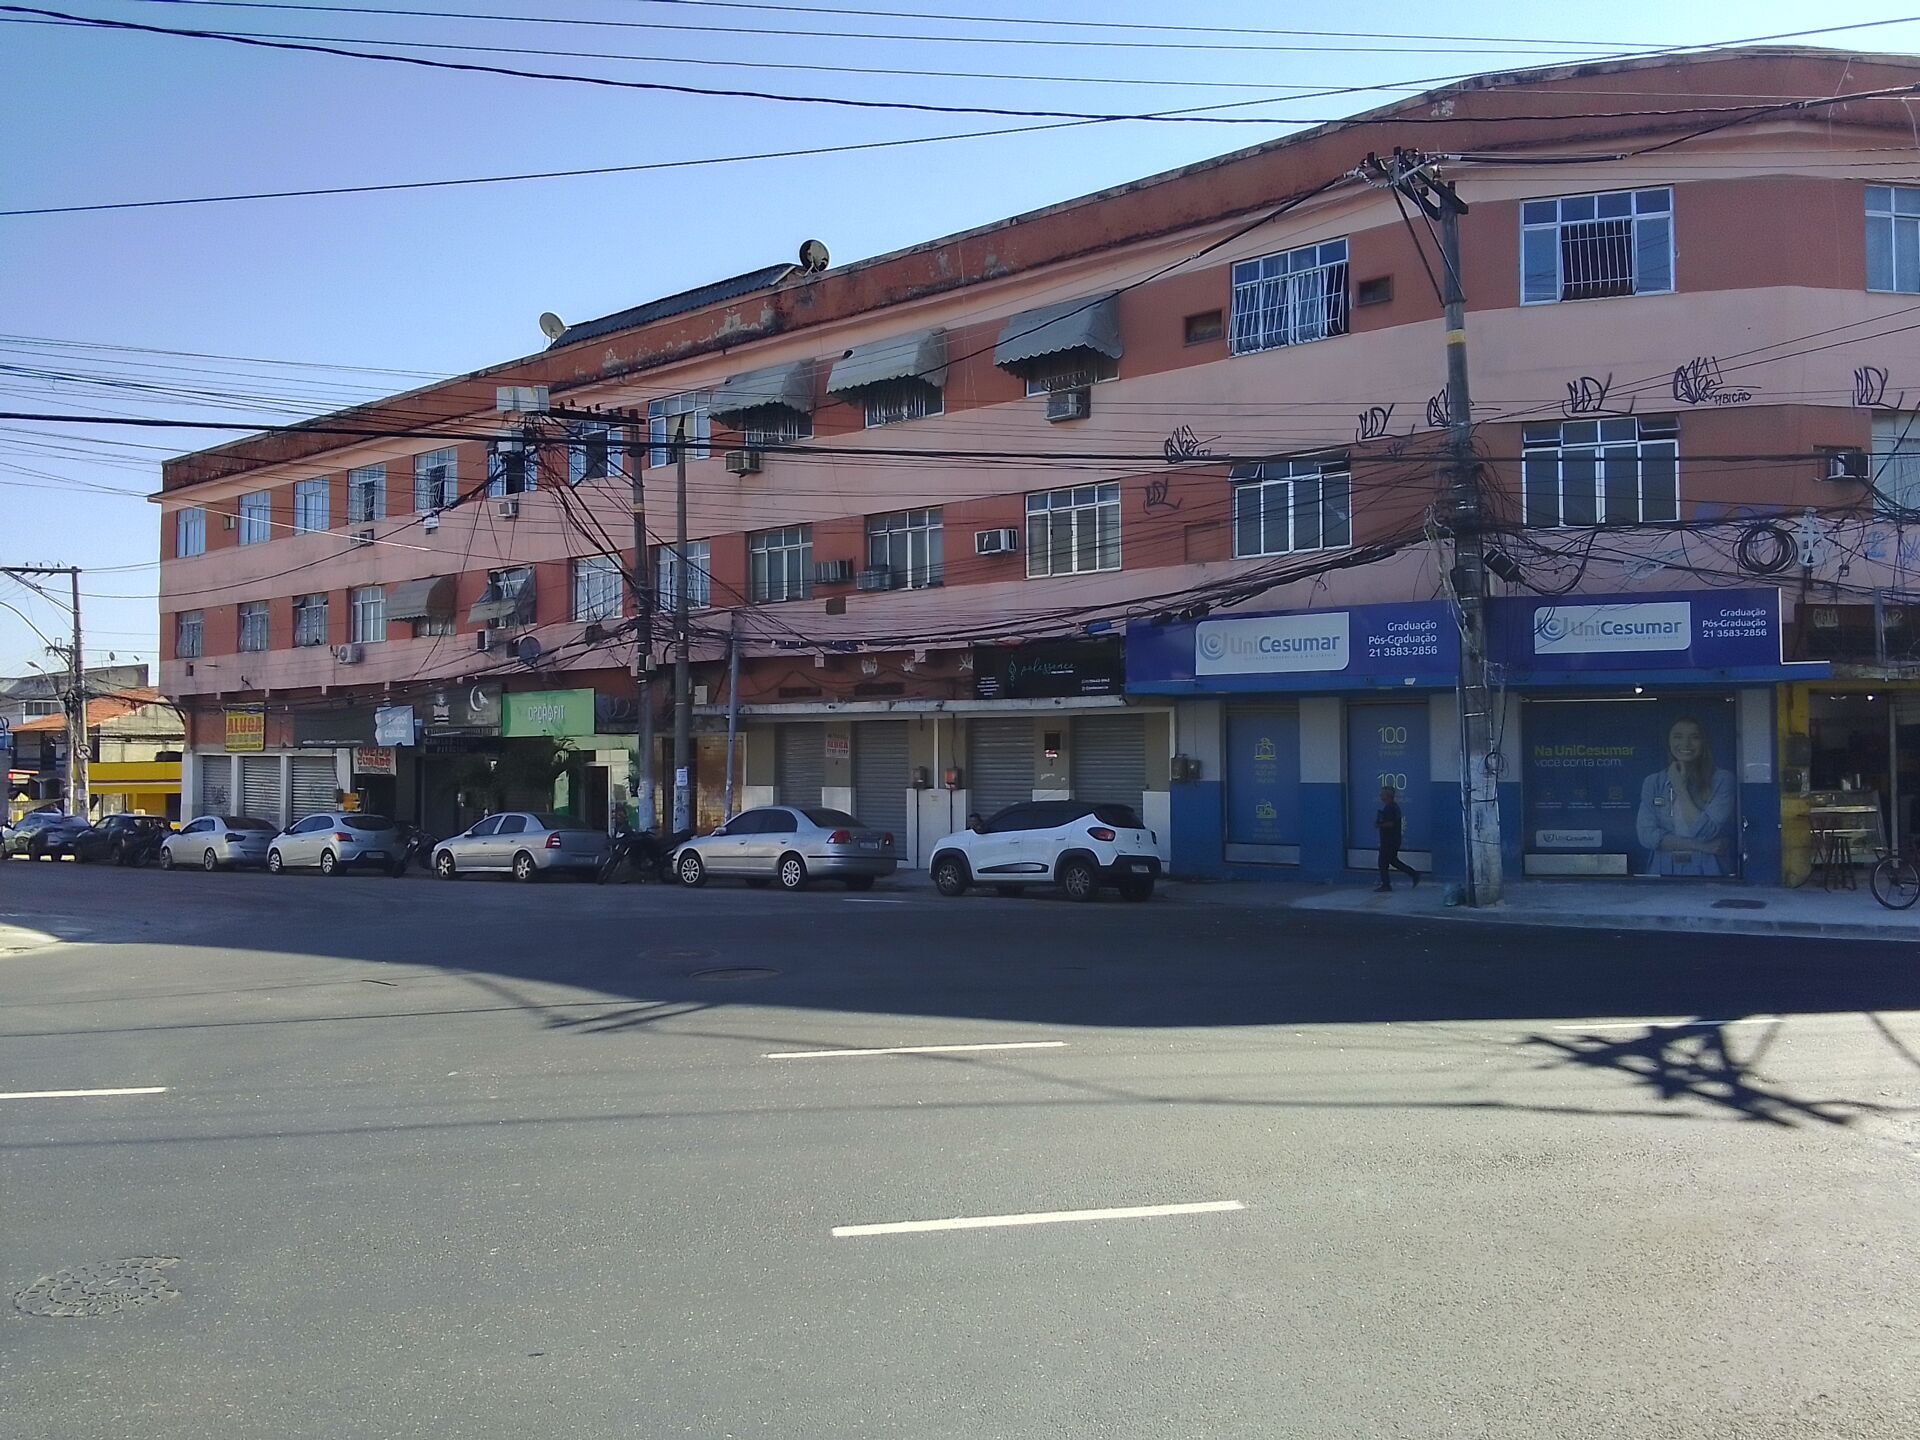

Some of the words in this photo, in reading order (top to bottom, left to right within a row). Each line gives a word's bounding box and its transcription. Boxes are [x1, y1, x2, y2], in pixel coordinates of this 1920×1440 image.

[1719, 608, 1767, 619] Graduação
[1387, 620, 1438, 633] Graduação
[1571, 620, 1683, 637] UniCesumar
[1702, 618, 1767, 630] Pós-Graduação
[1368, 633, 1438, 646] Pós-Graduação
[1703, 629, 1715, 638] 21
[1716, 628, 1767, 638] 3583-2856
[1230, 634, 1340, 655] UniCesumar
[1368, 647, 1381, 658] 21
[1383, 645, 1438, 658] 3583-2856
[1377, 726, 1407, 744] 100
[1534, 745, 1553, 757] Na
[1554, 744, 1634, 757] UniCesumar
[1596, 758, 1622, 767] com
[1377, 773, 1407, 791] 100
